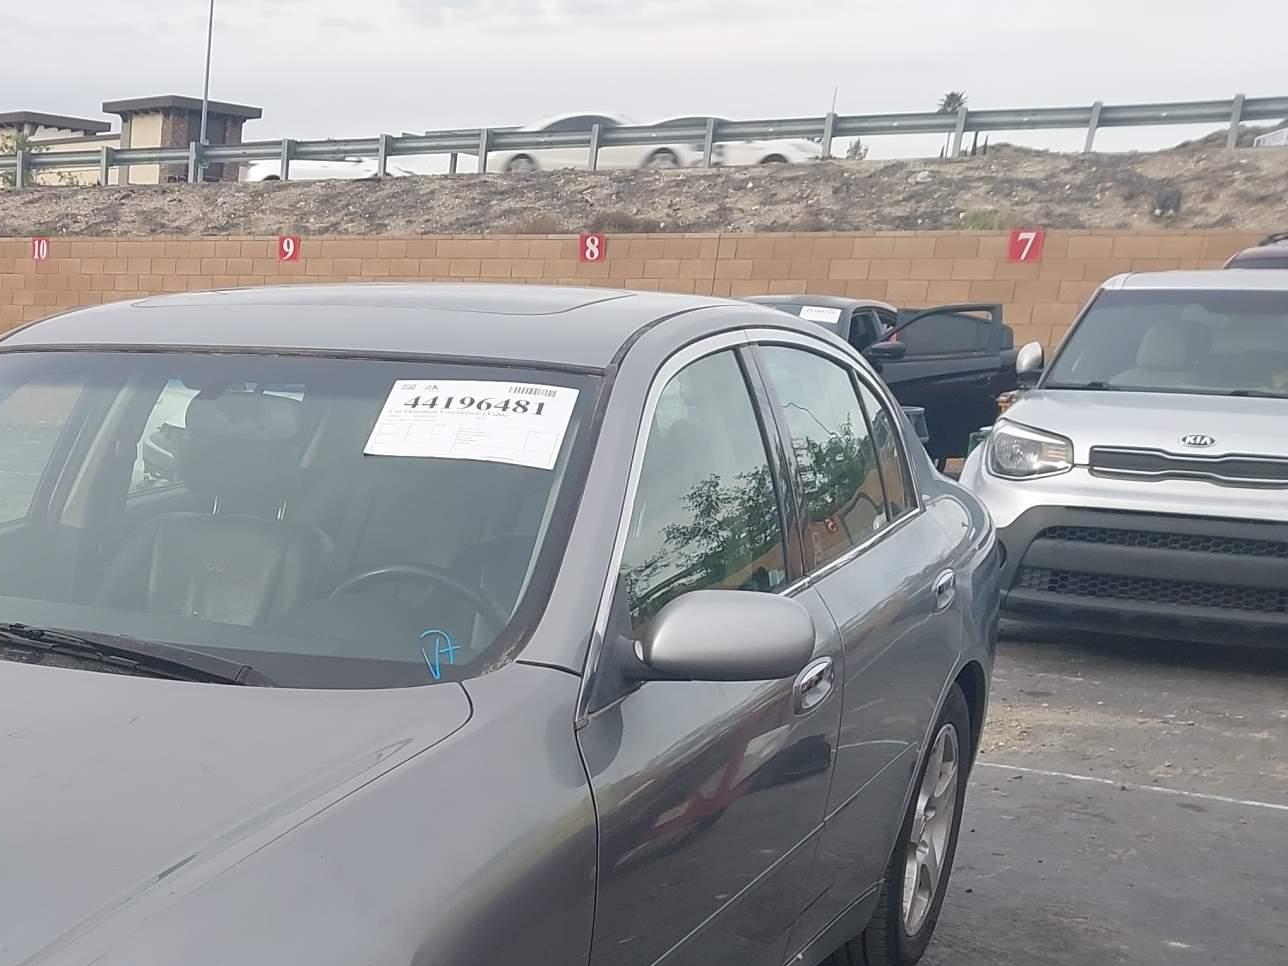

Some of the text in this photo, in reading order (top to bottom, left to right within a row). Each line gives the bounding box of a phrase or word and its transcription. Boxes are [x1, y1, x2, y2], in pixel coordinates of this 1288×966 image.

[33, 240, 47, 259] 10
[282, 238, 294, 260] 9
[585, 236, 599, 260] 8
[1017, 232, 1037, 260] 7
[404, 395, 546, 416] 44196481
